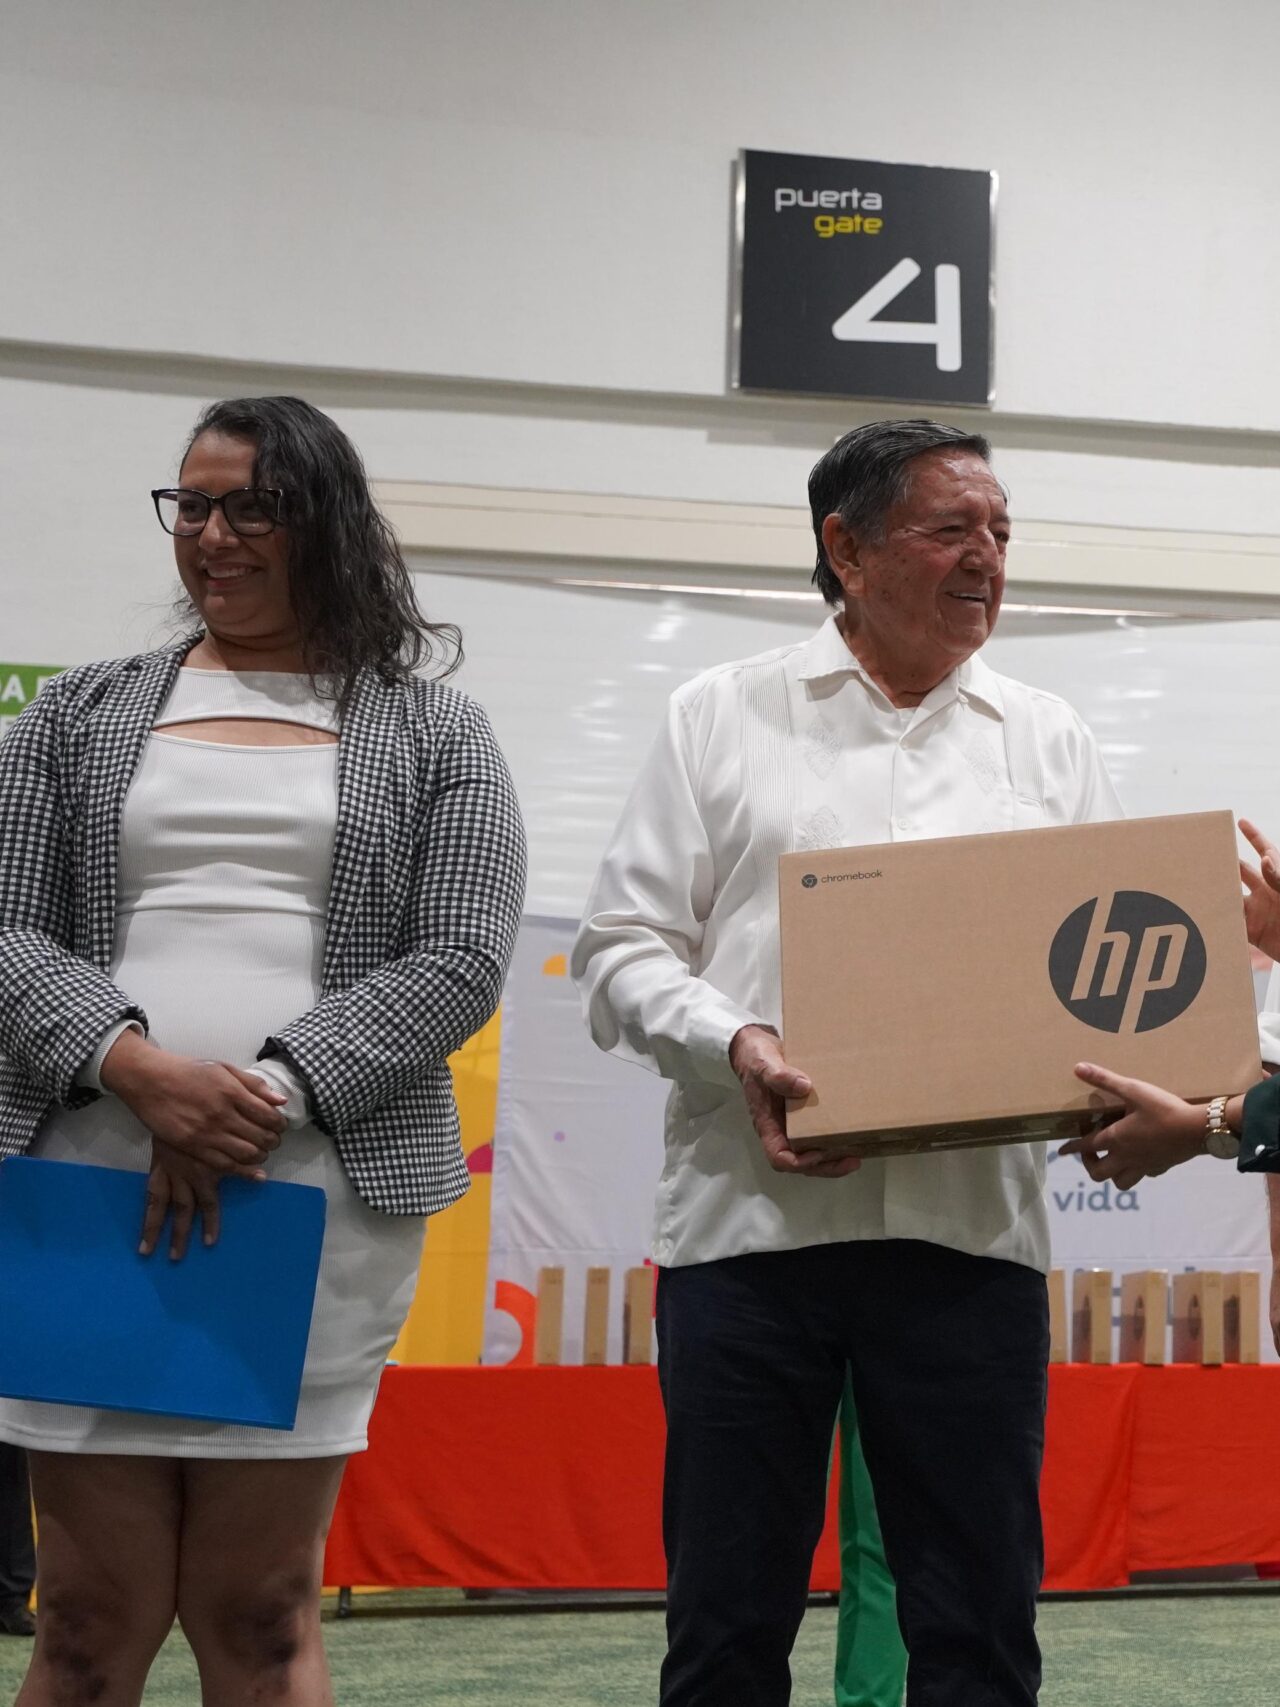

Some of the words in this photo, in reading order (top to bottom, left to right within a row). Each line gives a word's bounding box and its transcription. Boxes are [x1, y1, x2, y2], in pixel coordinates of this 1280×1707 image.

[775, 188, 882, 213] puerta
[814, 214, 883, 238] gate
[832, 257, 962, 372] 4
[820, 868, 883, 884] chromebook
[1069, 889, 1190, 1034] hp
[1053, 1181, 1140, 1212] vida
